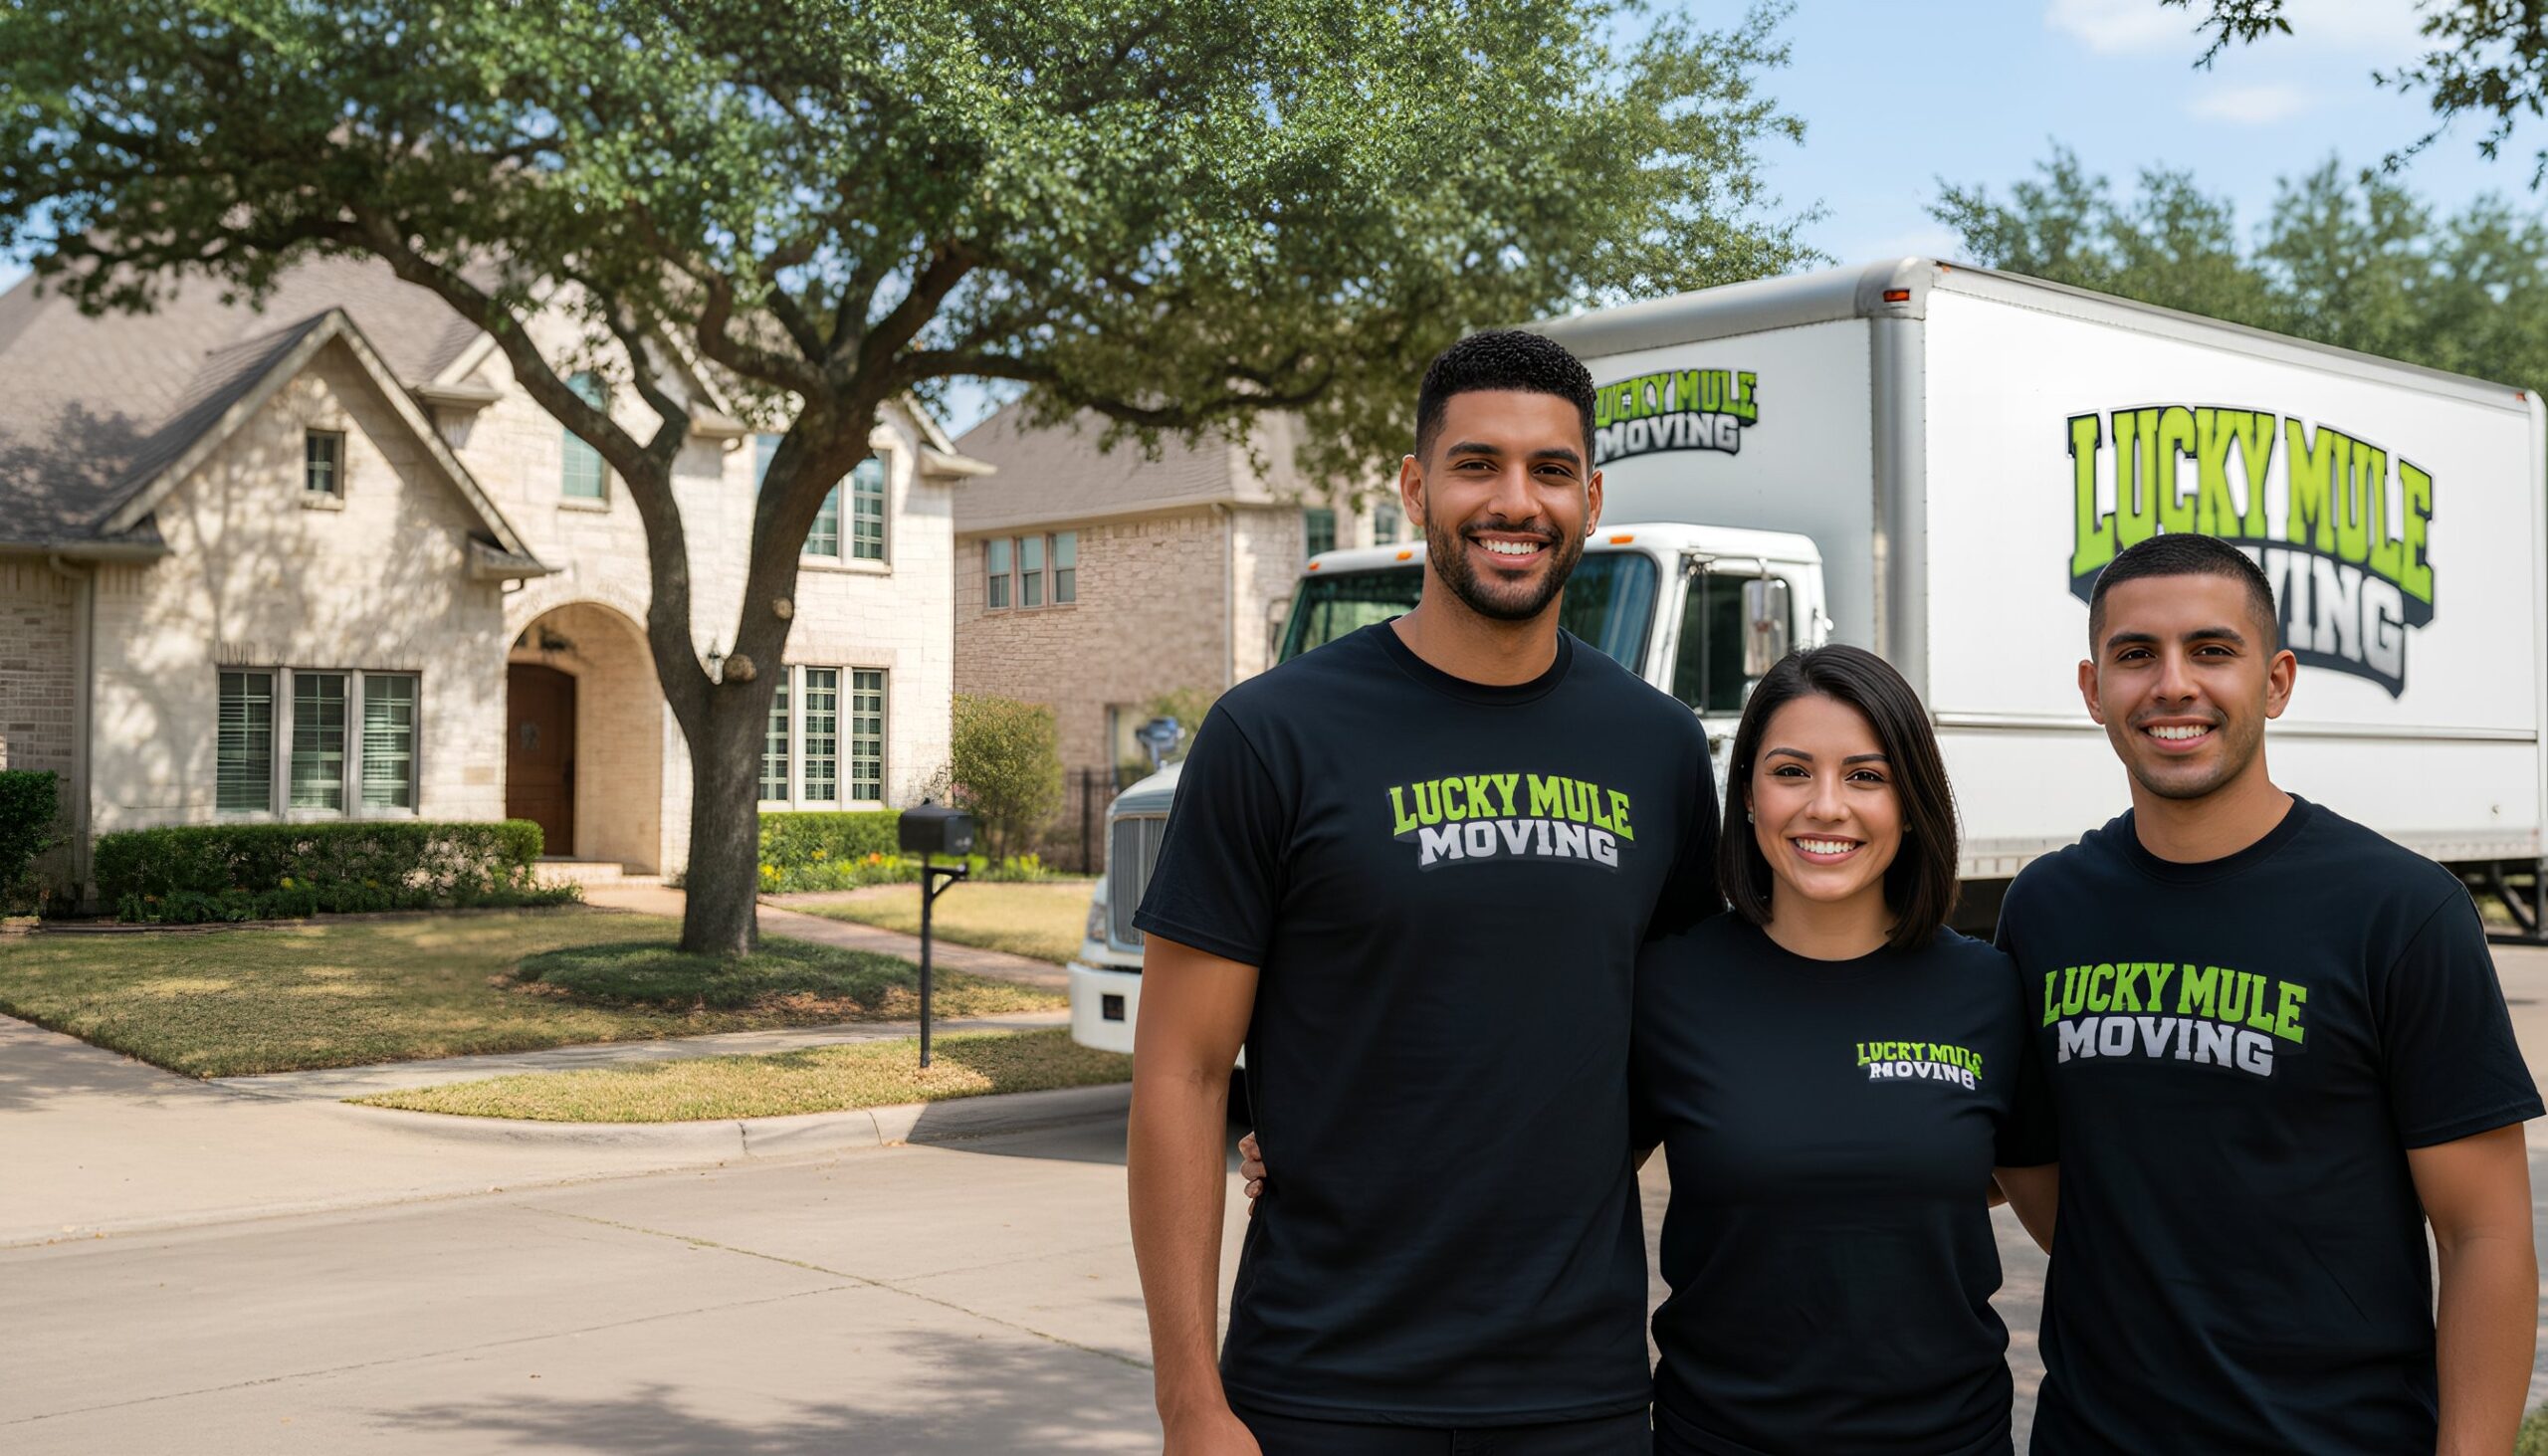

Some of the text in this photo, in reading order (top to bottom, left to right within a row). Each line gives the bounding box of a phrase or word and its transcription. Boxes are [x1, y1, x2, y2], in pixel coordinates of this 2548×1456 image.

[1595, 369, 1758, 428] UCKY MULE
[1594, 412, 1740, 465] MOVING
[2070, 406, 2434, 605] LUCKY MULE
[2236, 545, 2405, 680] VING
[1389, 773, 1634, 841] LUCKY MULE
[1418, 819, 1618, 868] MOVING
[2043, 962, 2307, 1044] LUCKY MULE
[1869, 1061, 1976, 1091] MOVING
[2057, 1016, 2274, 1077] MOVING
